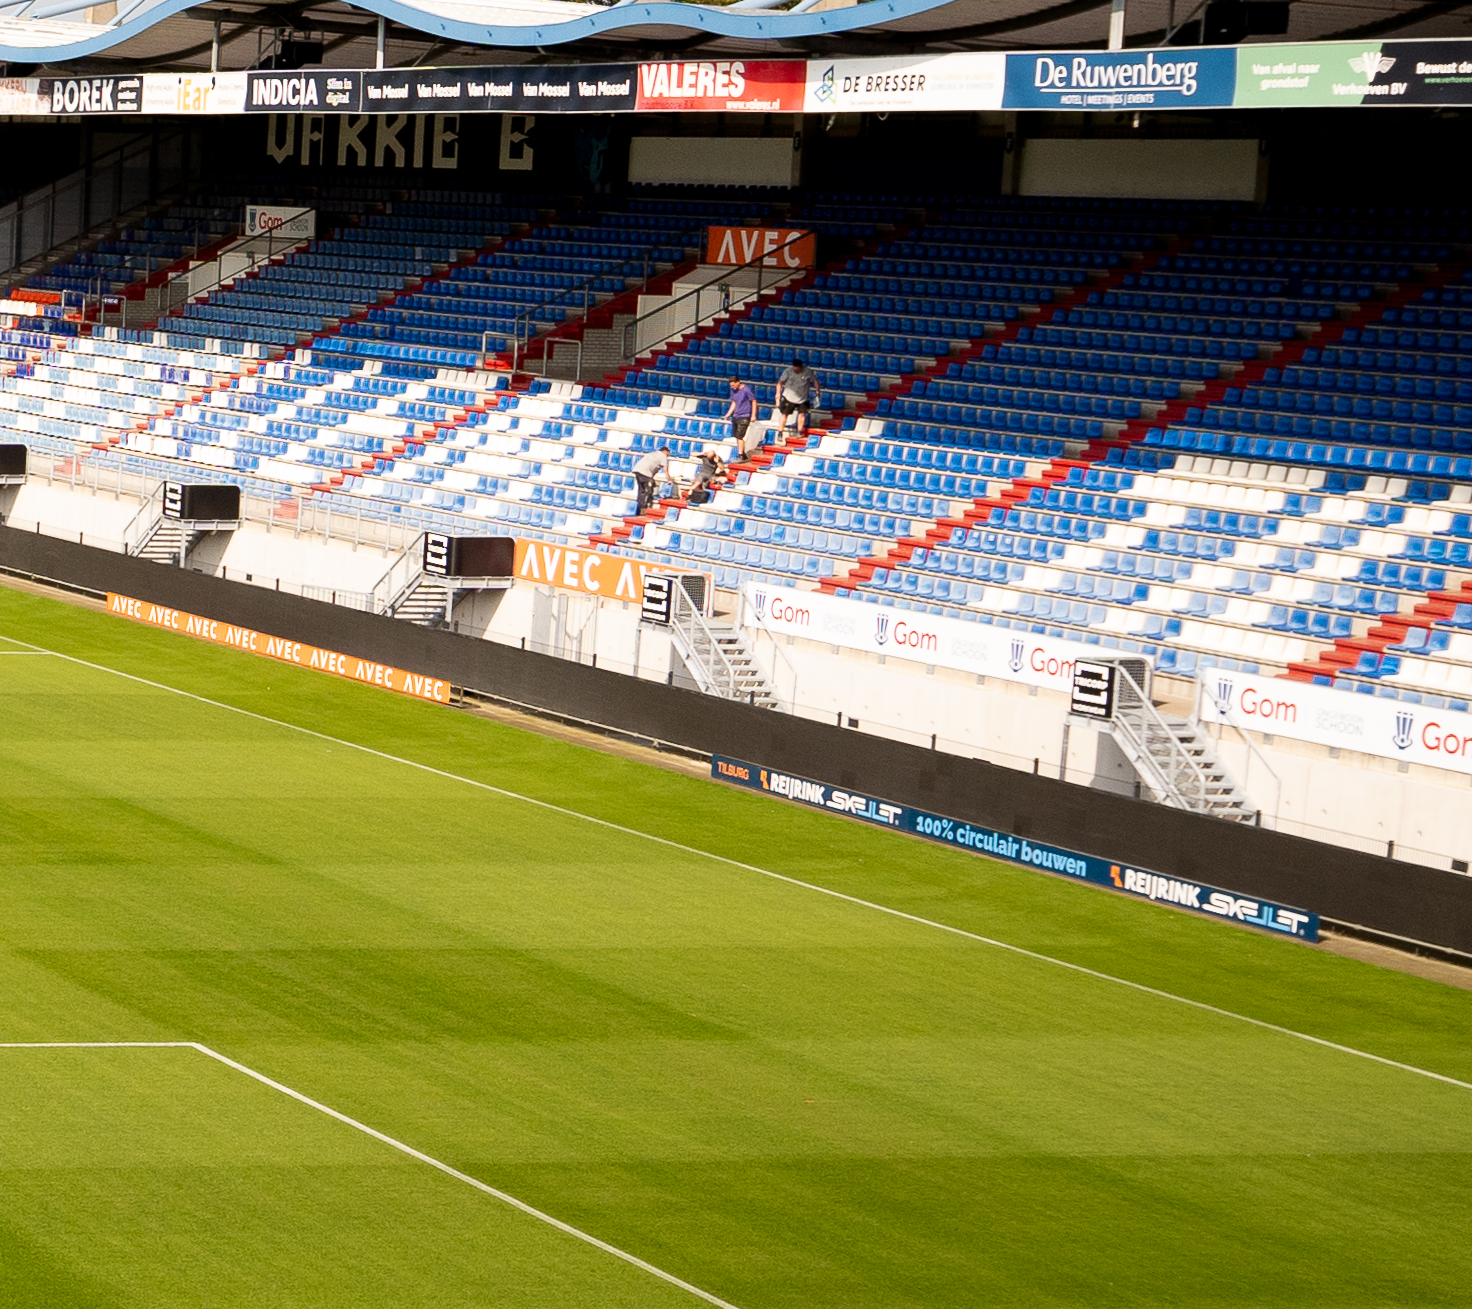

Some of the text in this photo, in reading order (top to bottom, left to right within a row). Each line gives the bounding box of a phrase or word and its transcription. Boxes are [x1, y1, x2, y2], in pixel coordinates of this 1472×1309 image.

[642, 61, 745, 97] VALERES
[1034, 53, 1198, 96] De Ruwenberg
[1252, 63, 1321, 75] Van afval naar
[1416, 61, 1458, 74] Bewust
[52, 79, 114, 113] BOREK
[252, 78, 318, 105] INDICIA
[367, 83, 409, 99] Van Mossel
[417, 82, 461, 97] Van Mossel
[467, 82, 513, 97] Van Mossel
[523, 82, 570, 97] Van Mossel
[578, 80, 630, 97] Van Mossel
[843, 76, 860, 93] DE
[866, 74, 926, 92] BRESSER
[1391, 82, 1407, 95] BV
[258, 212, 283, 231] Gom
[717, 228, 801, 268] AVEC
[520, 544, 601, 594] AVEC
[111, 595, 142, 618] AVEC
[148, 606, 180, 630] AVEC
[770, 598, 811, 627] Gom
[185, 616, 218, 640] AVEC
[224, 625, 258, 652] AVEC
[894, 623, 938, 653] Gom
[266, 637, 302, 663] AVEC
[310, 647, 347, 674] AVEC
[1030, 647, 1076, 679] Gom
[354, 660, 394, 687] AVEC
[403, 673, 444, 700] AVEC
[1240, 687, 1297, 723] Gom
[1315, 719, 1364, 736] SCHOON
[717, 760, 750, 783] TILBURG
[770, 772, 825, 804] REIJRINK
[915, 814, 1087, 876] 100% circulair bouwen
[1123, 868, 1201, 910] REIJRINK
